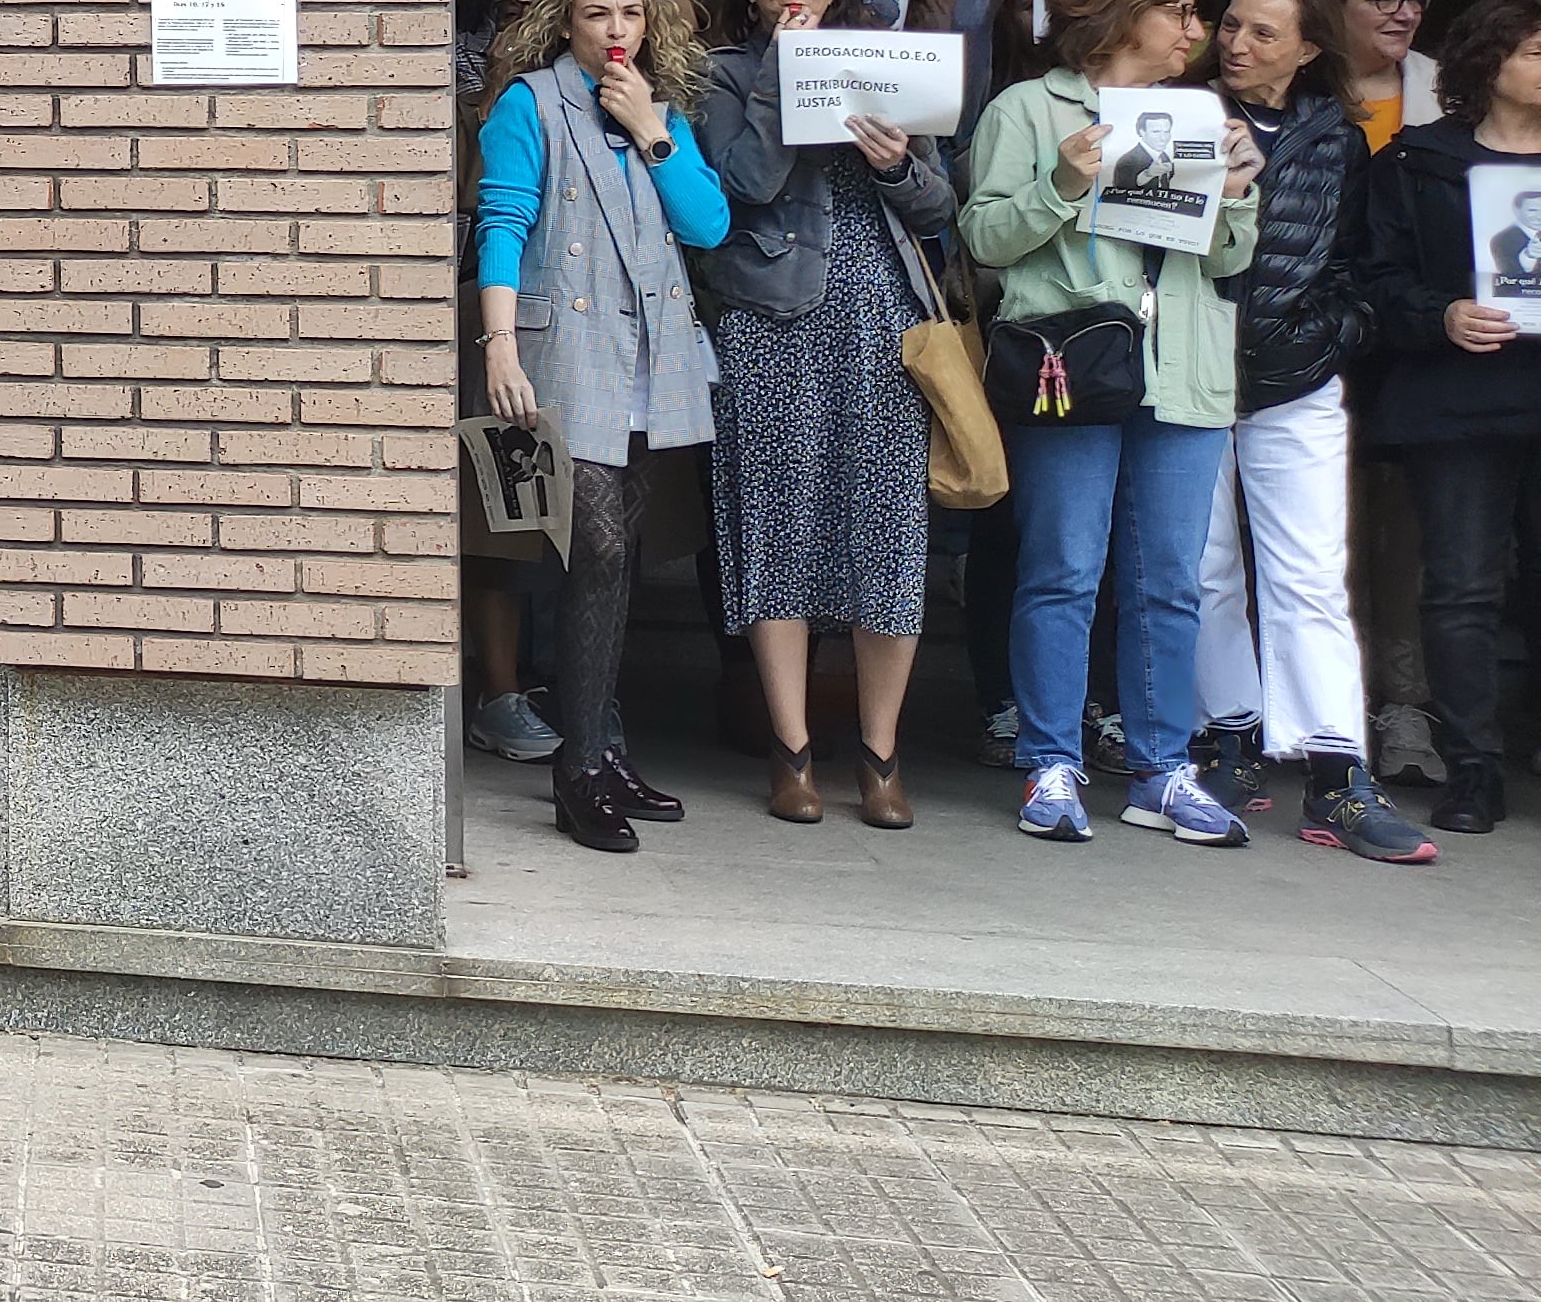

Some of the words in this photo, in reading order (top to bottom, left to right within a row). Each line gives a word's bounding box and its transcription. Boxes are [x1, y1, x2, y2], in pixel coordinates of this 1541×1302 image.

[795, 47, 885, 59] DEROGACION
[796, 79, 899, 94] RETRIBUCIONES
[795, 96, 842, 108] JUSTAS
[1145, 189, 1154, 197] A
[1156, 189, 1169, 199] TI
